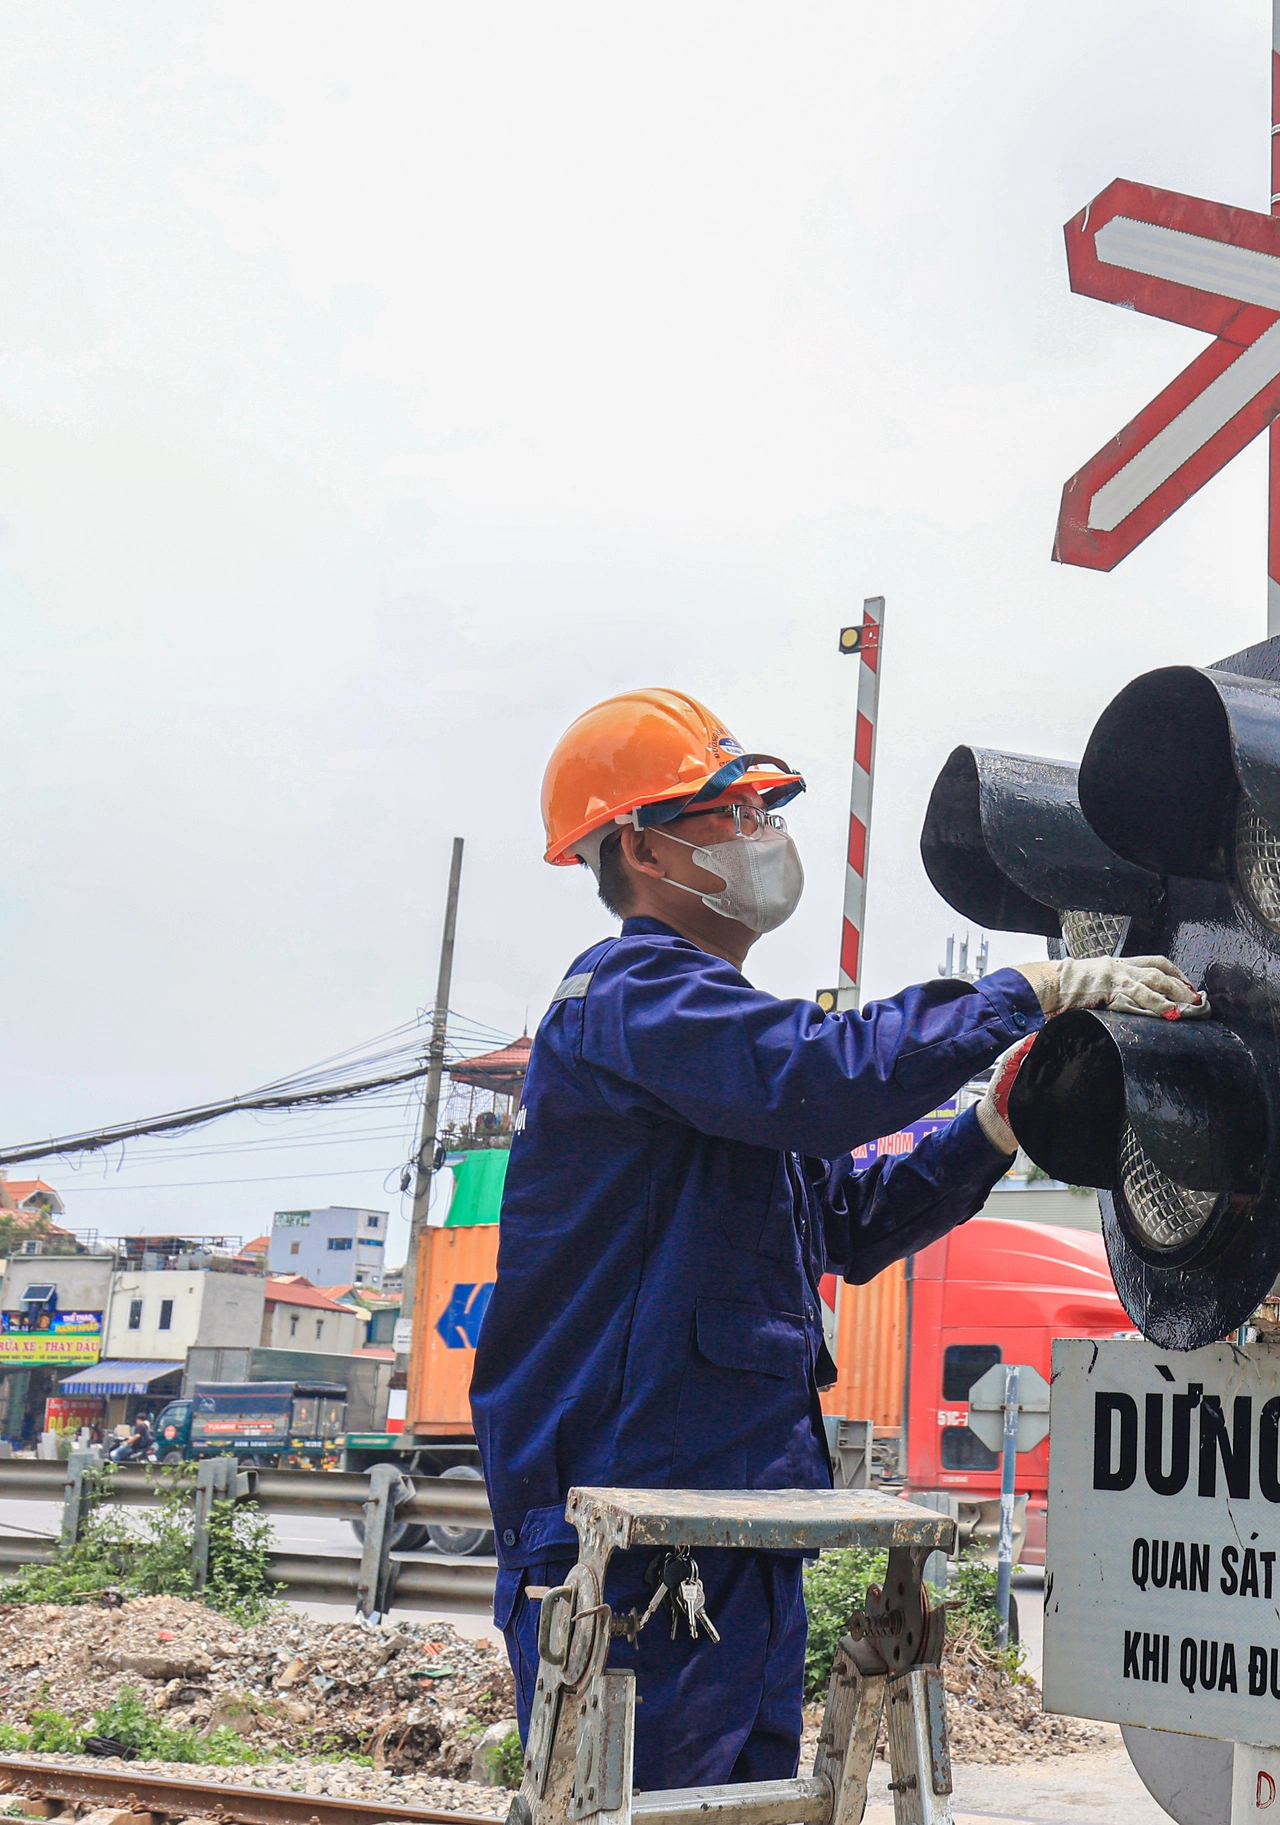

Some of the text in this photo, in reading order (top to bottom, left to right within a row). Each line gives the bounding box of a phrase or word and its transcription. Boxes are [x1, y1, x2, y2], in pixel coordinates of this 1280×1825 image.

[22, 1341, 36, 1351] XE
[45, 1341, 73, 1351] THAY
[1131, 1537, 1210, 1592] QUAN
[1220, 1532, 1276, 1599] SÁT
[1122, 1630, 1170, 1684] KHI
[1180, 1637, 1239, 1694] QUA
